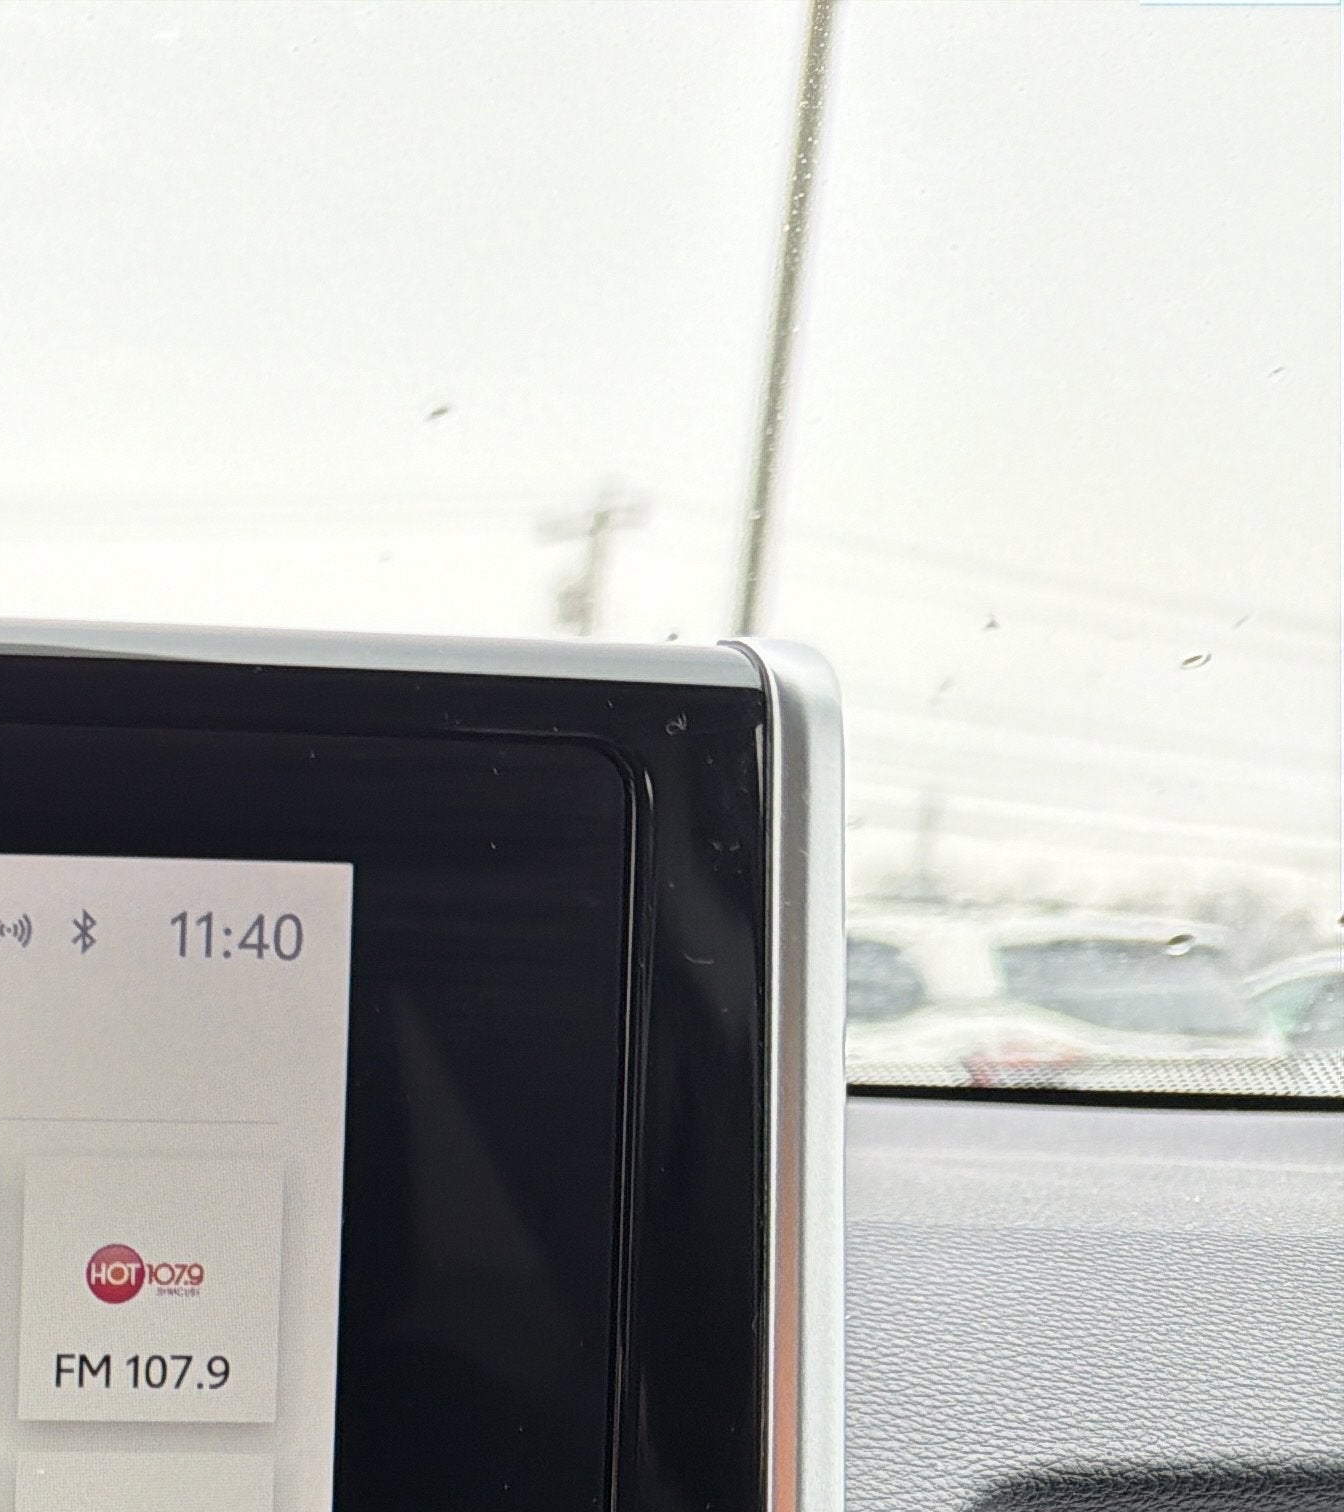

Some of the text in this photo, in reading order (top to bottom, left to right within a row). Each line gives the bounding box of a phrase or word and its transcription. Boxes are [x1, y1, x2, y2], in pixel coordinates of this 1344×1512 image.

[169, 909, 305, 963] 11:40
[91, 1261, 141, 1286] HOT
[54, 1352, 231, 1391] FM 107.9
